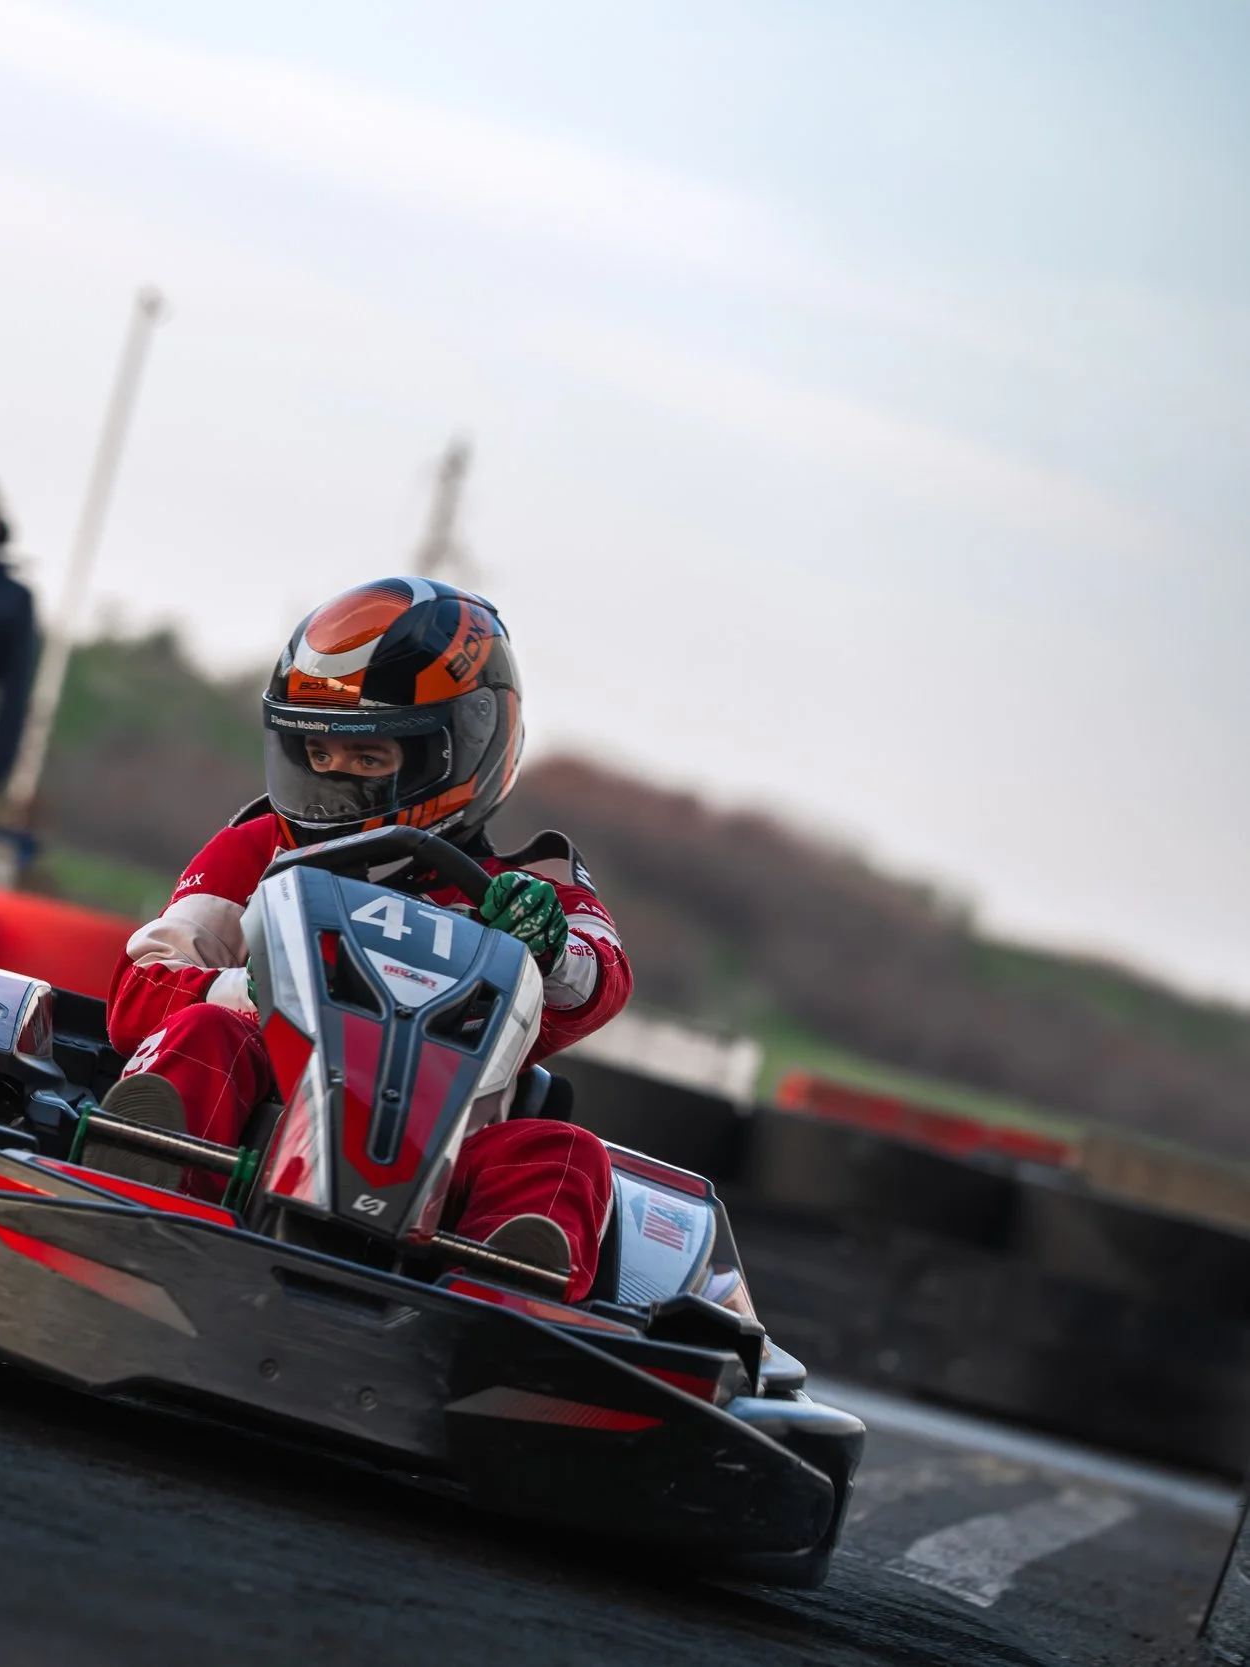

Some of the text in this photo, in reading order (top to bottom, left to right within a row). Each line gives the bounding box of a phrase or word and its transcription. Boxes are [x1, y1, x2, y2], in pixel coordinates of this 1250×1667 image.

[297, 720, 329, 733] Mobility
[331, 722, 376, 733] Company
[350, 895, 454, 960] 41
